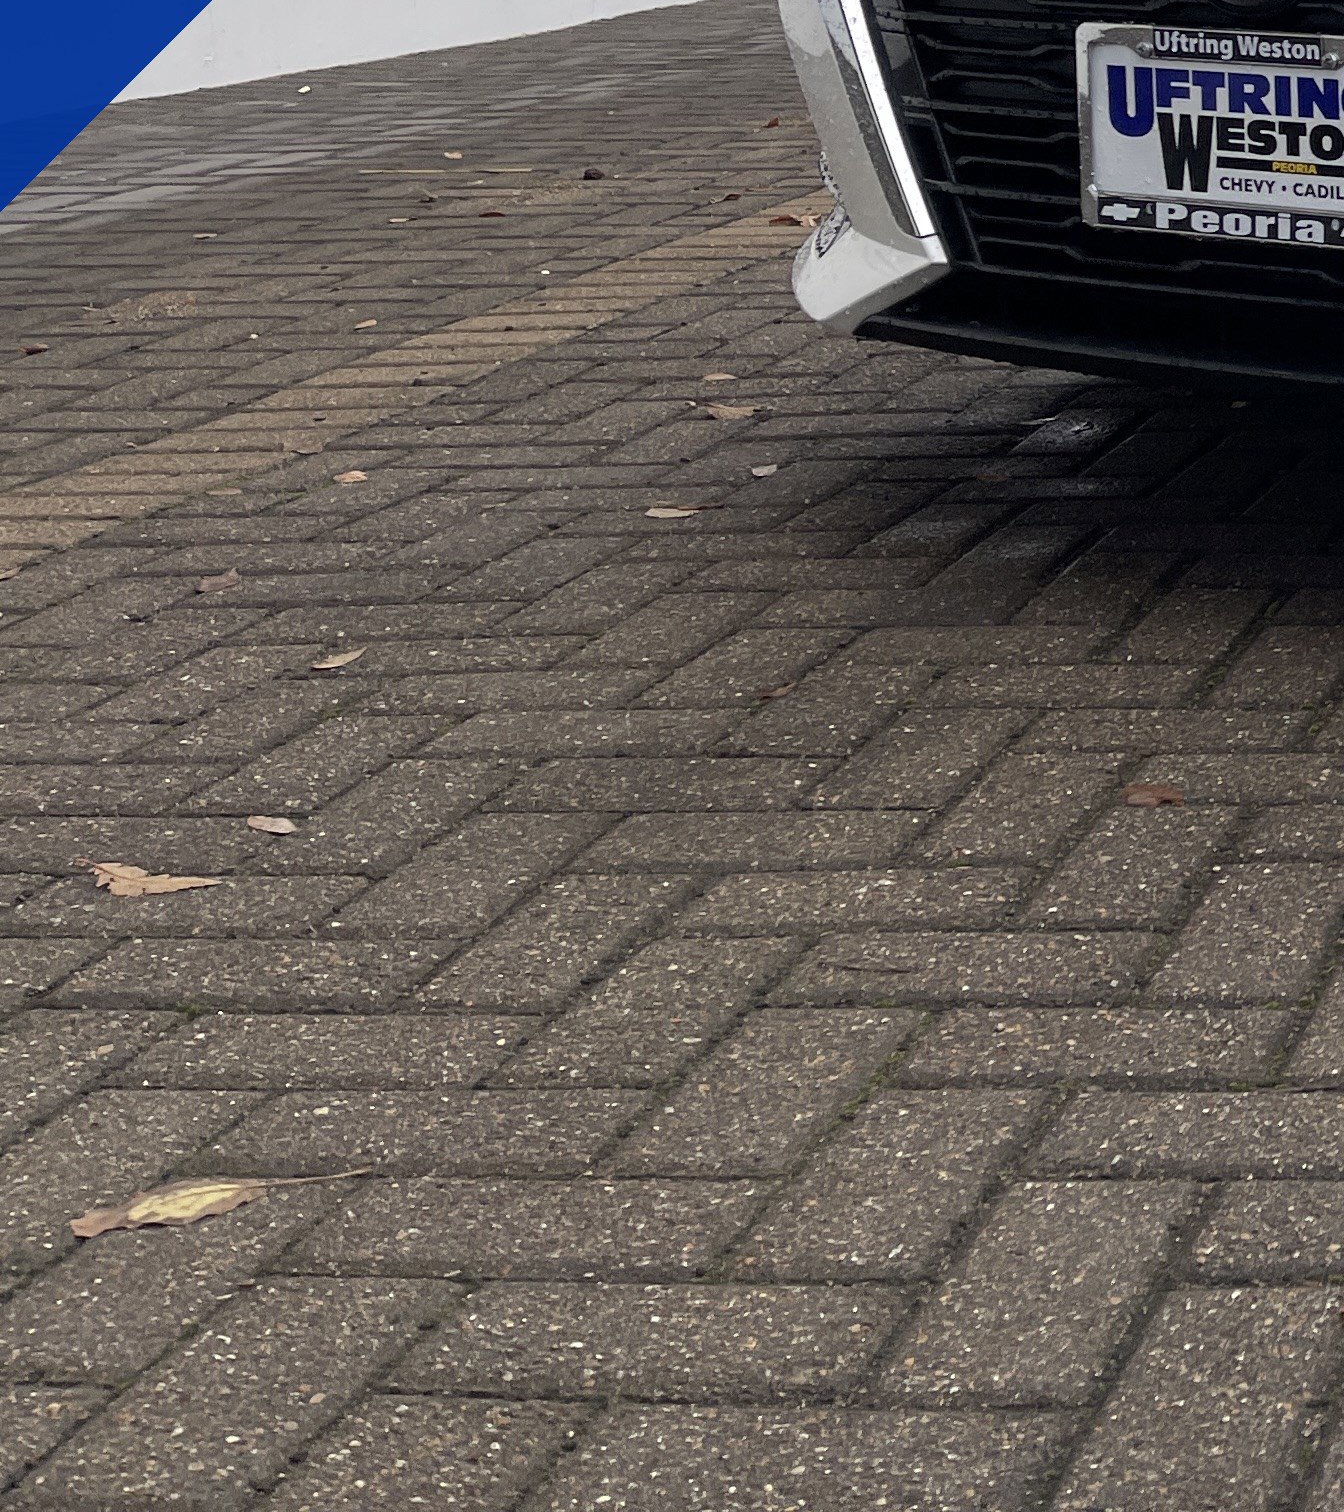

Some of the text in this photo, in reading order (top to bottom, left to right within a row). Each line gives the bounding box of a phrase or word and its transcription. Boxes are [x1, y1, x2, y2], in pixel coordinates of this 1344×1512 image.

[1153, 30, 1320, 62] Uftring Weston
[1271, 161, 1318, 175] PEORIA
[1219, 176, 1275, 194] CHEVY
[1155, 201, 1326, 244] Peoria
